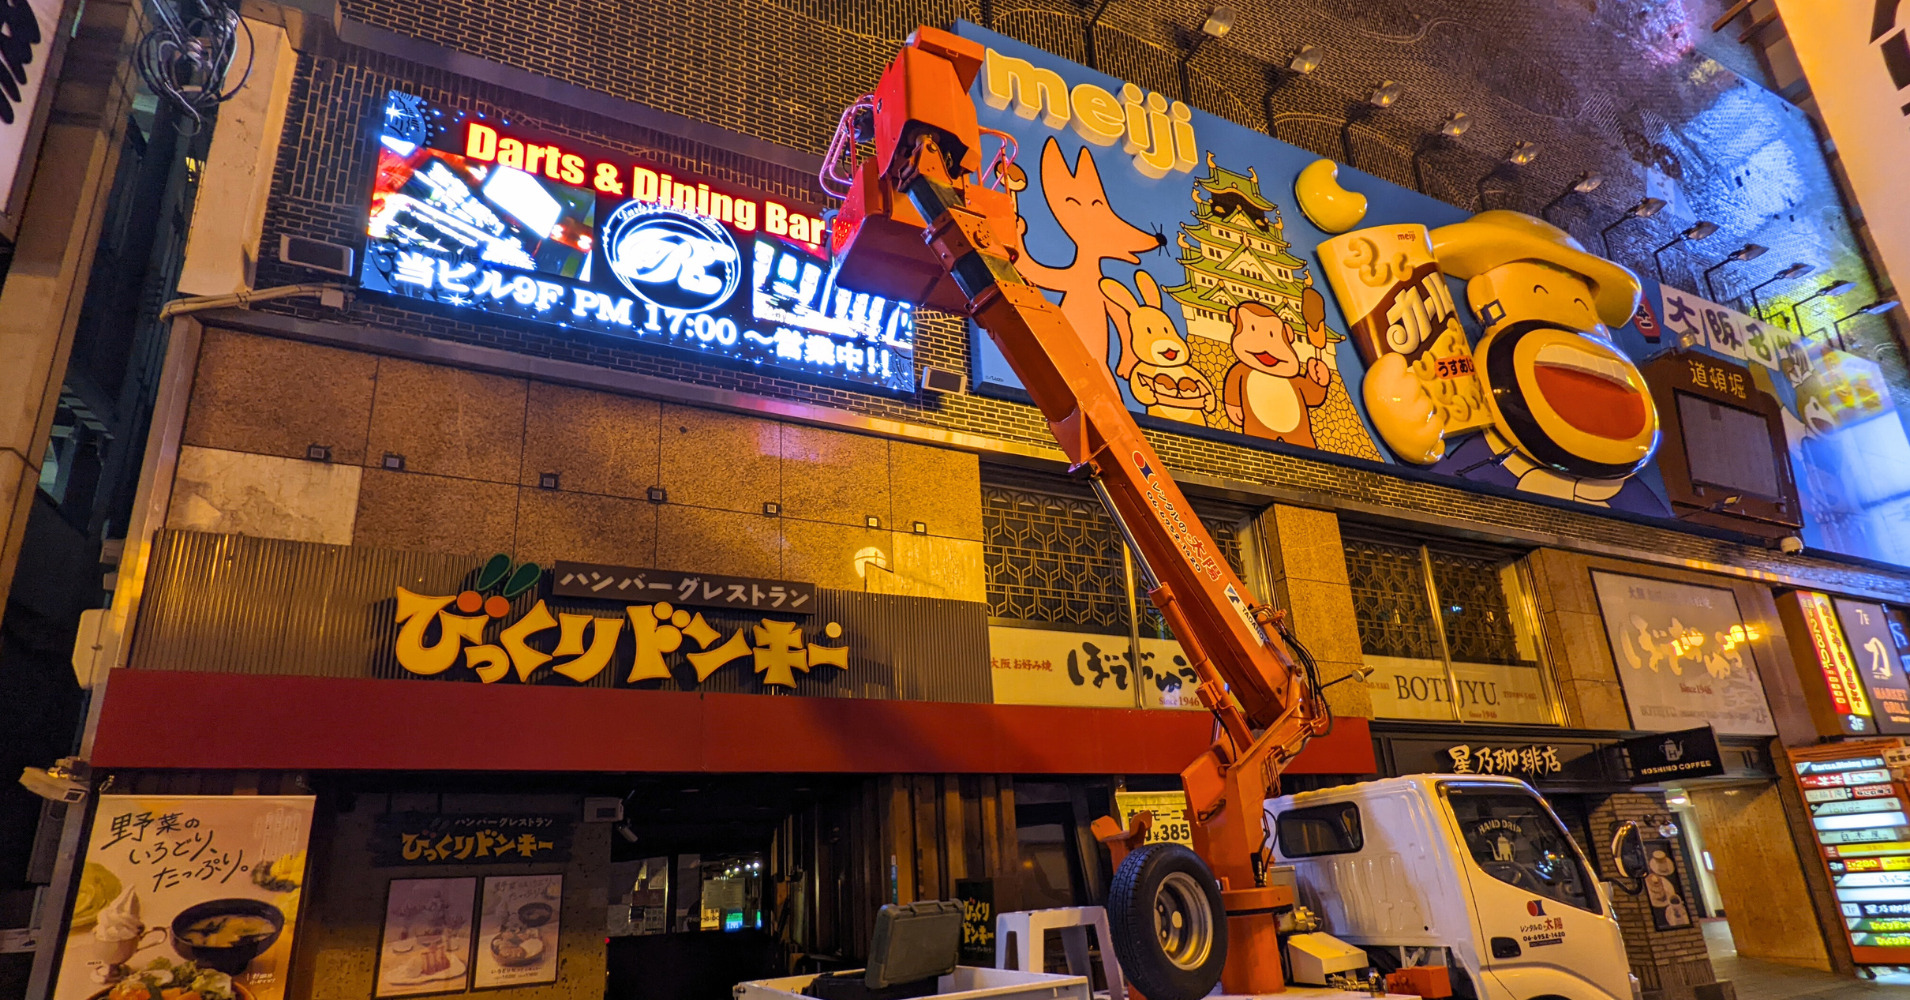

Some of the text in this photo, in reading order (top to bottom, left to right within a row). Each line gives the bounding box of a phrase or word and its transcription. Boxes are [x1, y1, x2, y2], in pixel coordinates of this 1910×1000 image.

[982, 47, 1198, 180] meiji
[466, 123, 585, 184] Darts
[594, 163, 623, 194] &
[633, 167, 756, 231] Dining
[765, 203, 825, 244] Bar
[1397, 233, 1416, 242] meiji
[394, 252, 564, 312] 当ビル9F
[572, 287, 633, 325] PM
[644, 302, 737, 345] 17:00
[1386, 271, 1455, 354] カール
[1688, 360, 1747, 399] 道頓堀
[1152, 480, 1223, 581] レンタルの太陽
[559, 570, 810, 609] ハンバーグレストラン
[395, 586, 849, 689] びっくりドンキー
[1179, 696, 1200, 707] 1946
[1394, 675, 1500, 708] BOTJYU.
[1448, 744, 1562, 776] 星乃珈琲店
[1641, 760, 1712, 775] HOSHINO COFFEE
[101, 812, 200, 850] 野菜の
[455, 817, 553, 828] ハンバーグレストラン
[1153, 824, 1190, 841] ¥385
[1478, 820, 1500, 834] HAND
[402, 829, 554, 862] びっくりドンキー
